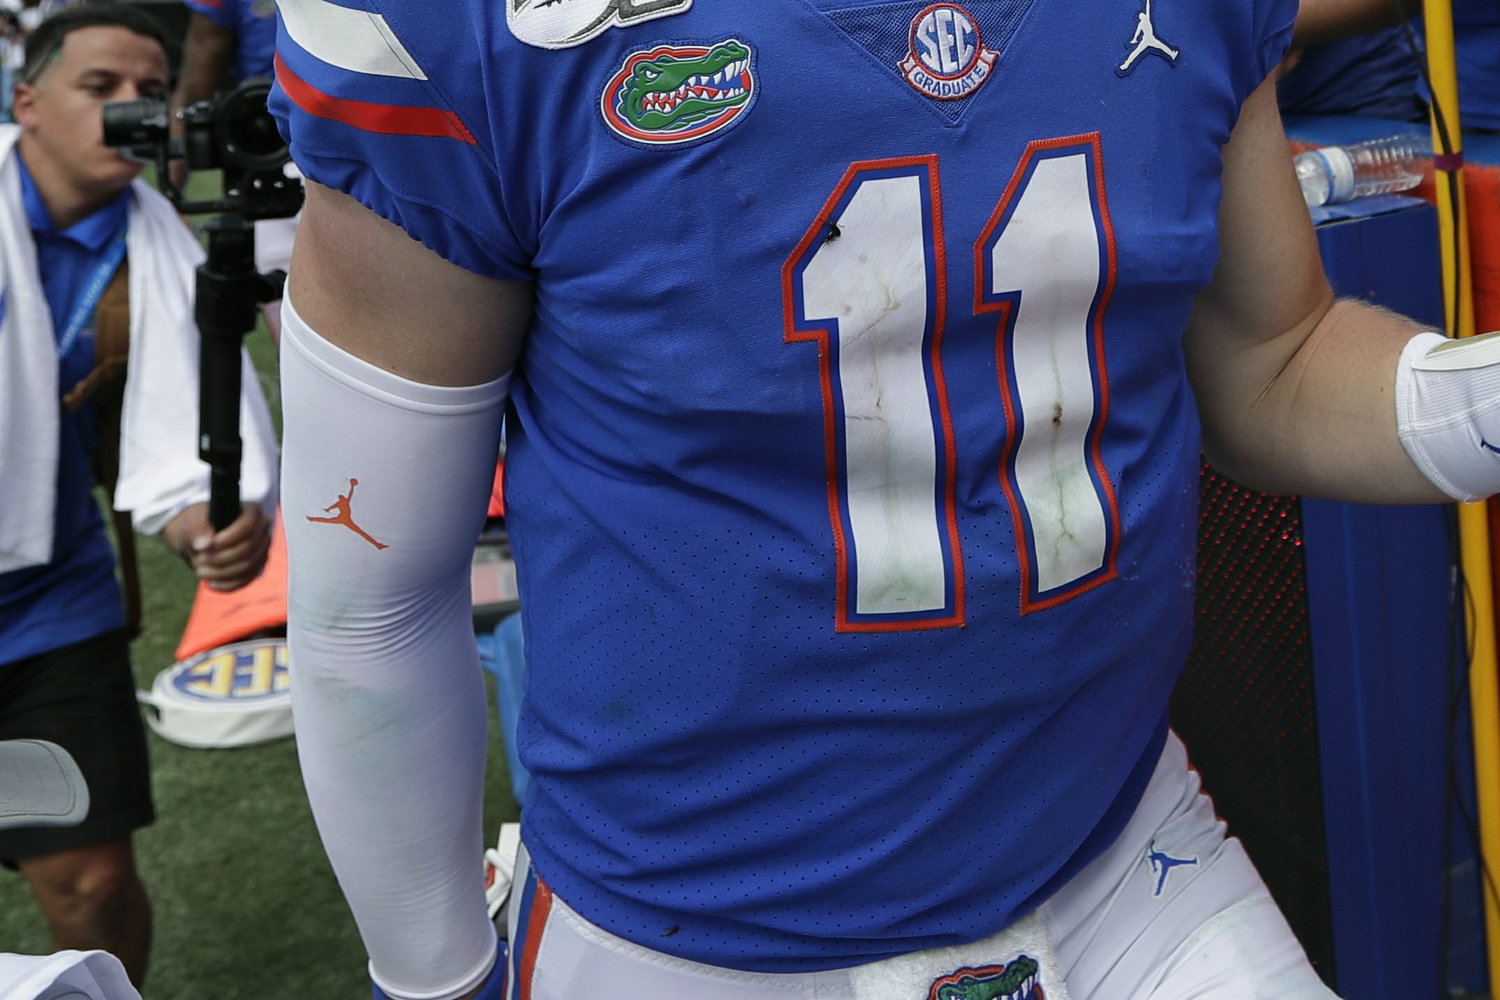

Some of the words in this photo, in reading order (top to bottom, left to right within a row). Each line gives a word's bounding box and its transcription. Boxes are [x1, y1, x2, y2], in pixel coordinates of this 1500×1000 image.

[916, 8, 975, 74] SEC
[913, 65, 986, 97] GRADUATE
[781, 131, 1118, 633] 11
